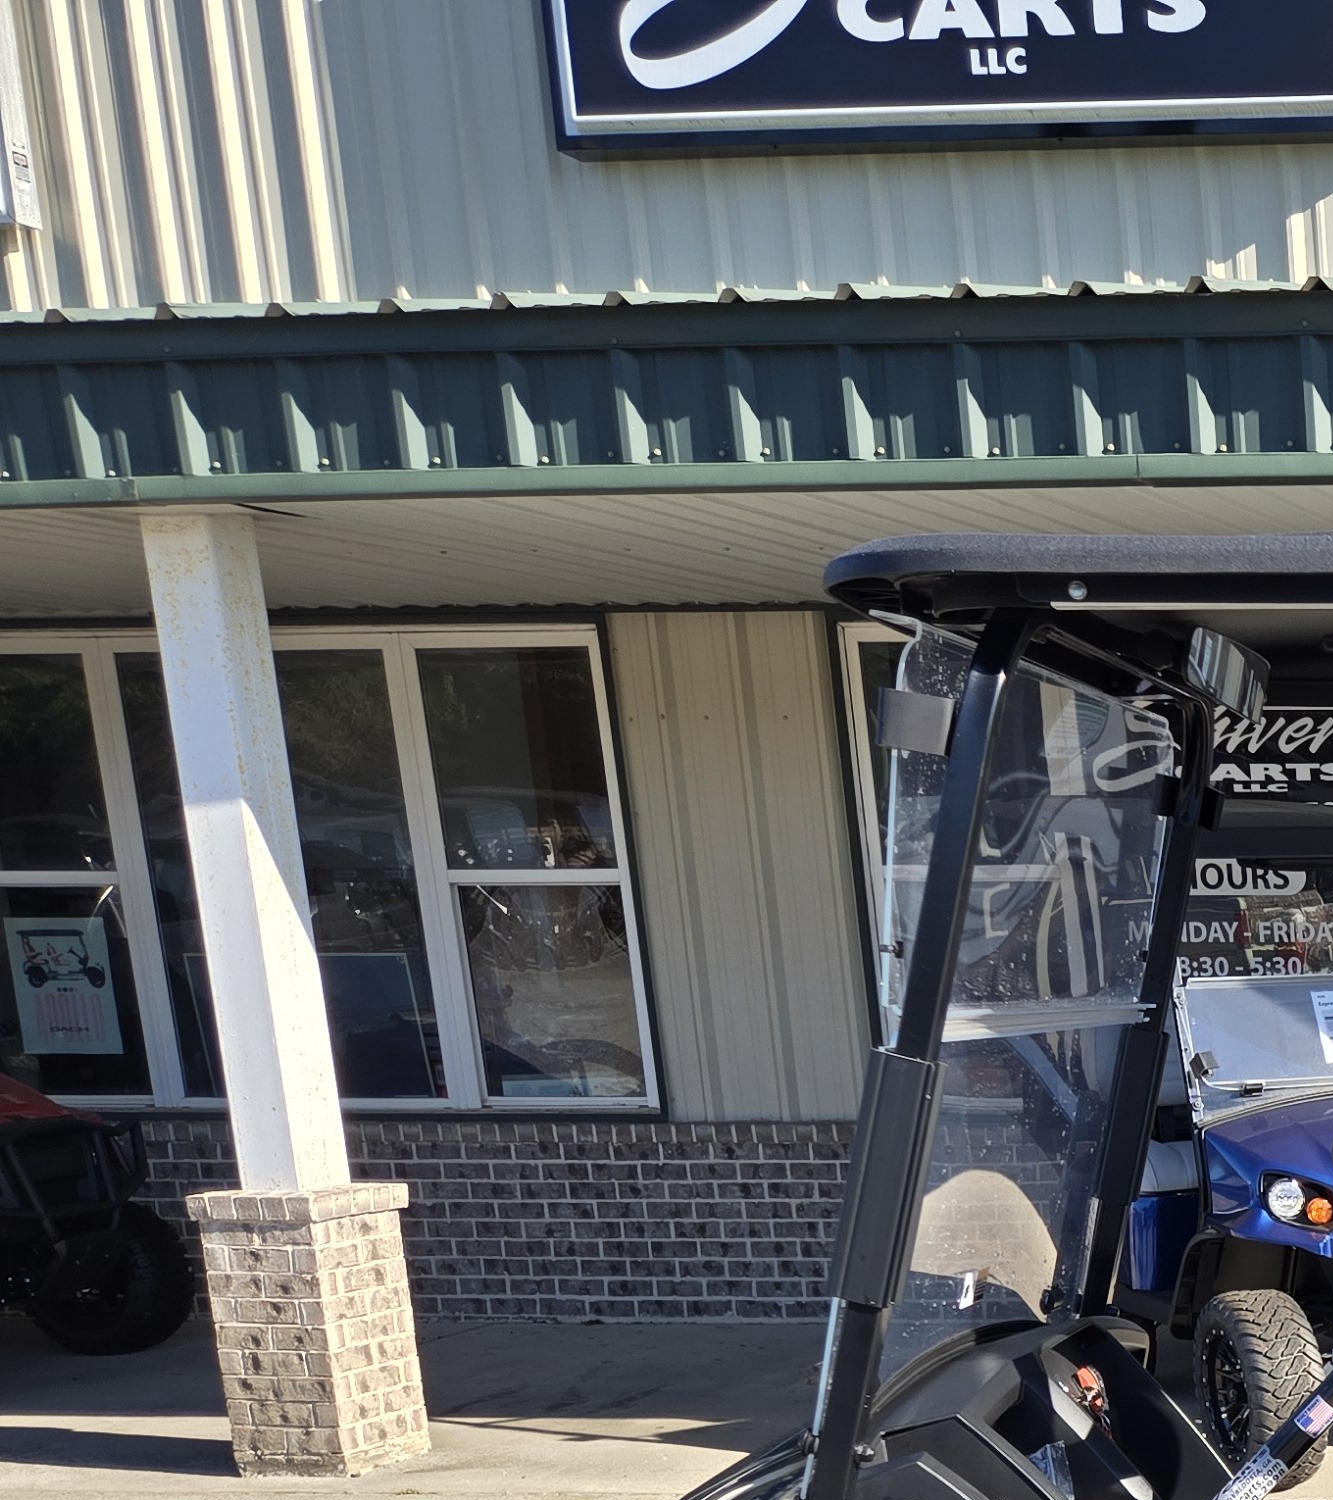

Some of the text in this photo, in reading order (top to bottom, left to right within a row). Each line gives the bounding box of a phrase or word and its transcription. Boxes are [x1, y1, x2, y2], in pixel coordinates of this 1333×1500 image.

[837, 0, 1206, 42] CARTS
[970, 47, 1027, 75] LLC
[1233, 783, 1289, 793] LLC
[1128, 921, 1238, 944] MDAY
[1180, 956, 1229, 977] 8:30
[1250, 956, 1302, 977] 5:30
[1262, 1458, 1273, 1469] GA
